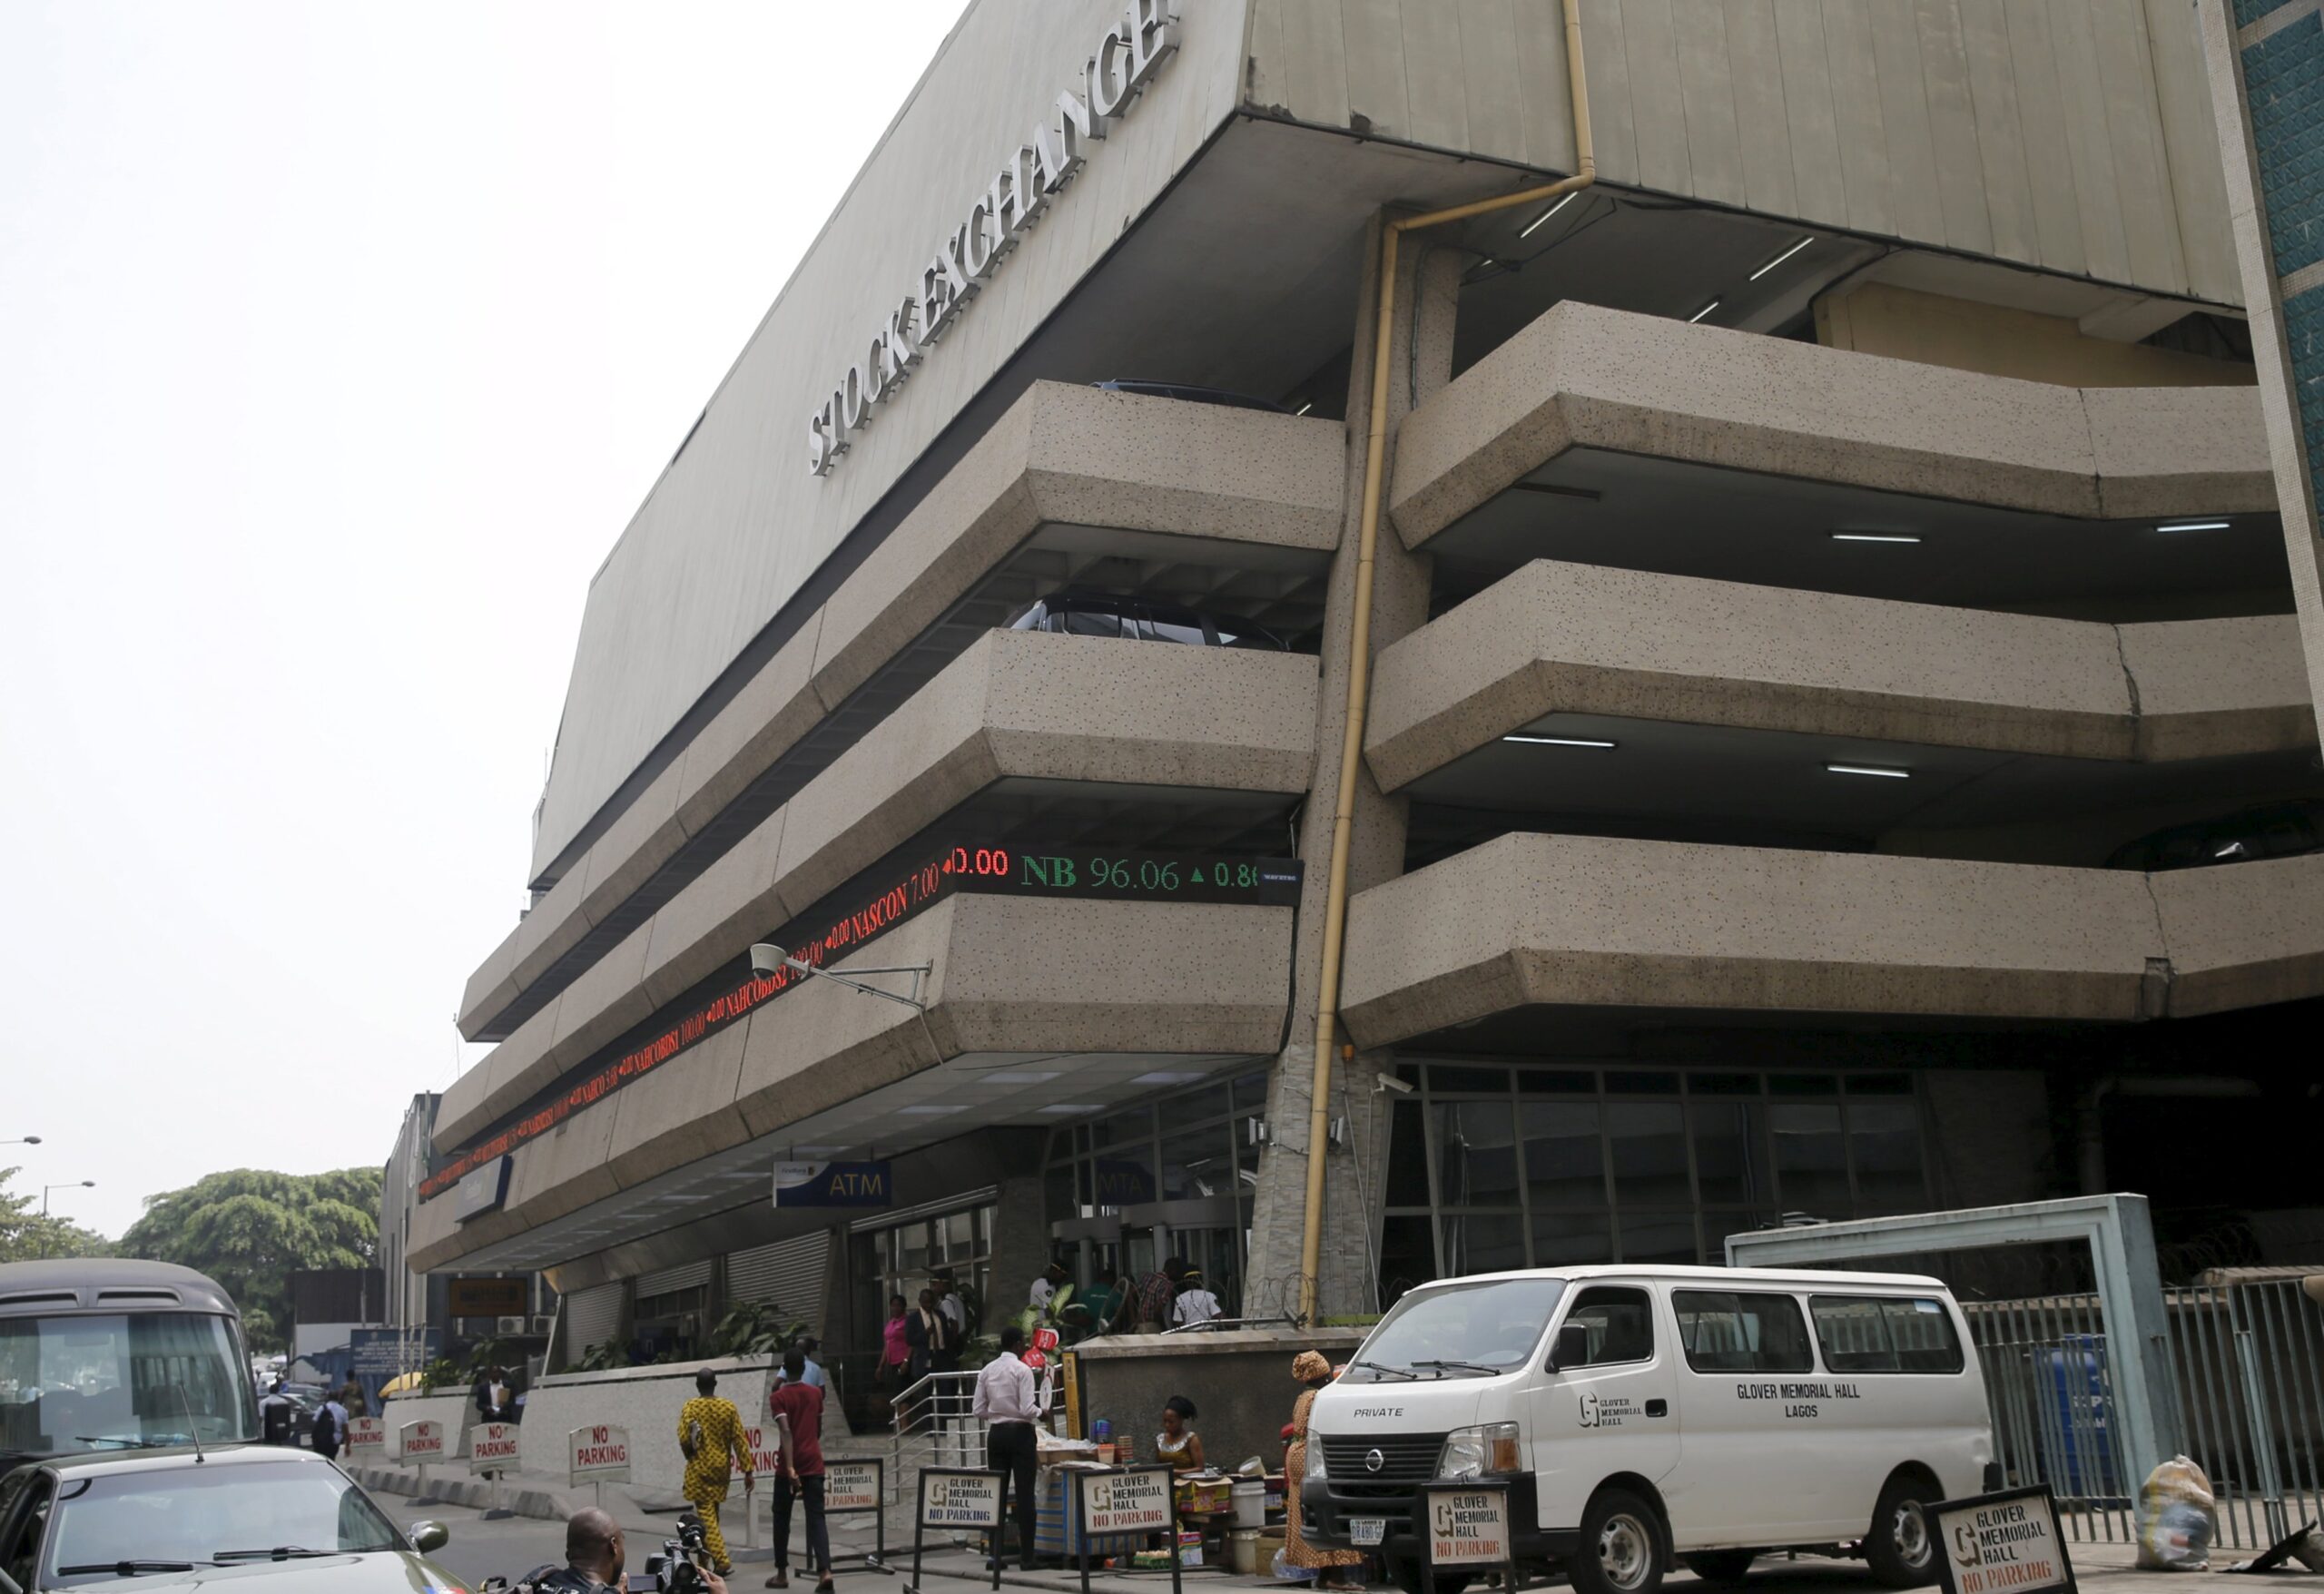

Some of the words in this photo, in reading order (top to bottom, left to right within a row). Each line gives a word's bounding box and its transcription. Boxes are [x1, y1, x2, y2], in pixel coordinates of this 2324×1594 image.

[808, 296, 922, 477] STOCK
[916, 0, 1176, 347] EXCHANGE
[1020, 856, 1076, 888] NB
[1089, 858, 1179, 890] 96.06
[832, 919, 850, 949] 0.00
[852, 882, 907, 944] NASCON
[911, 862, 939, 904] 7.00
[829, 1173, 882, 1196] ATM
[1737, 1384, 1777, 1399] GLOVER
[1779, 1383, 1832, 1399] MEMORIAL
[1834, 1383, 1860, 1399] HALL
[1600, 1399, 1630, 1407] GLOVER
[1354, 1408, 1404, 1418] PRIVATE
[1601, 1407, 1642, 1417] MEMORIAL
[1785, 1405, 1817, 1418] LAGOS
[359, 1419, 371, 1431] NO
[1601, 1418, 1622, 1426] HALL
[349, 1431, 383, 1443] PARKING
[418, 1424, 429, 1437] NO
[488, 1425, 503, 1440] NO
[592, 1426, 608, 1444] NO
[406, 1438, 441, 1453] PARKING
[476, 1440, 517, 1458] PARKING
[577, 1445, 626, 1466] PARKING
[730, 1451, 780, 1473] PKING
[833, 1467, 863, 1476] GLOVER
[833, 1476, 873, 1485] MEMORIAL
[950, 1479, 983, 1489] GLOVER
[1112, 1475, 1149, 1489] GLOVER
[832, 1494, 872, 1505] PARKING
[949, 1489, 993, 1500] MEMORIAL
[1113, 1487, 1163, 1500] MEMORIAL
[949, 1499, 970, 1509] HALL
[1113, 1500, 1138, 1510] HALL
[1453, 1496, 1488, 1509] GLOVER
[929, 1509, 943, 1520] NO
[947, 1509, 990, 1521] PARKING
[1092, 1513, 1109, 1529] NO
[1113, 1510, 1163, 1526] PARKING
[1455, 1510, 1499, 1524] MEMORIAL
[1976, 1505, 2026, 1528] GLOVER
[1456, 1525, 1479, 1538] HALL
[1980, 1520, 2046, 1547] MEMORIAL
[1436, 1541, 1452, 1558] NO
[1456, 1540, 1500, 1557] PARKING
[1983, 1546, 2019, 1564] HALL
[1962, 1572, 1984, 1594] NO
[1986, 1560, 2052, 1589] PARKING
